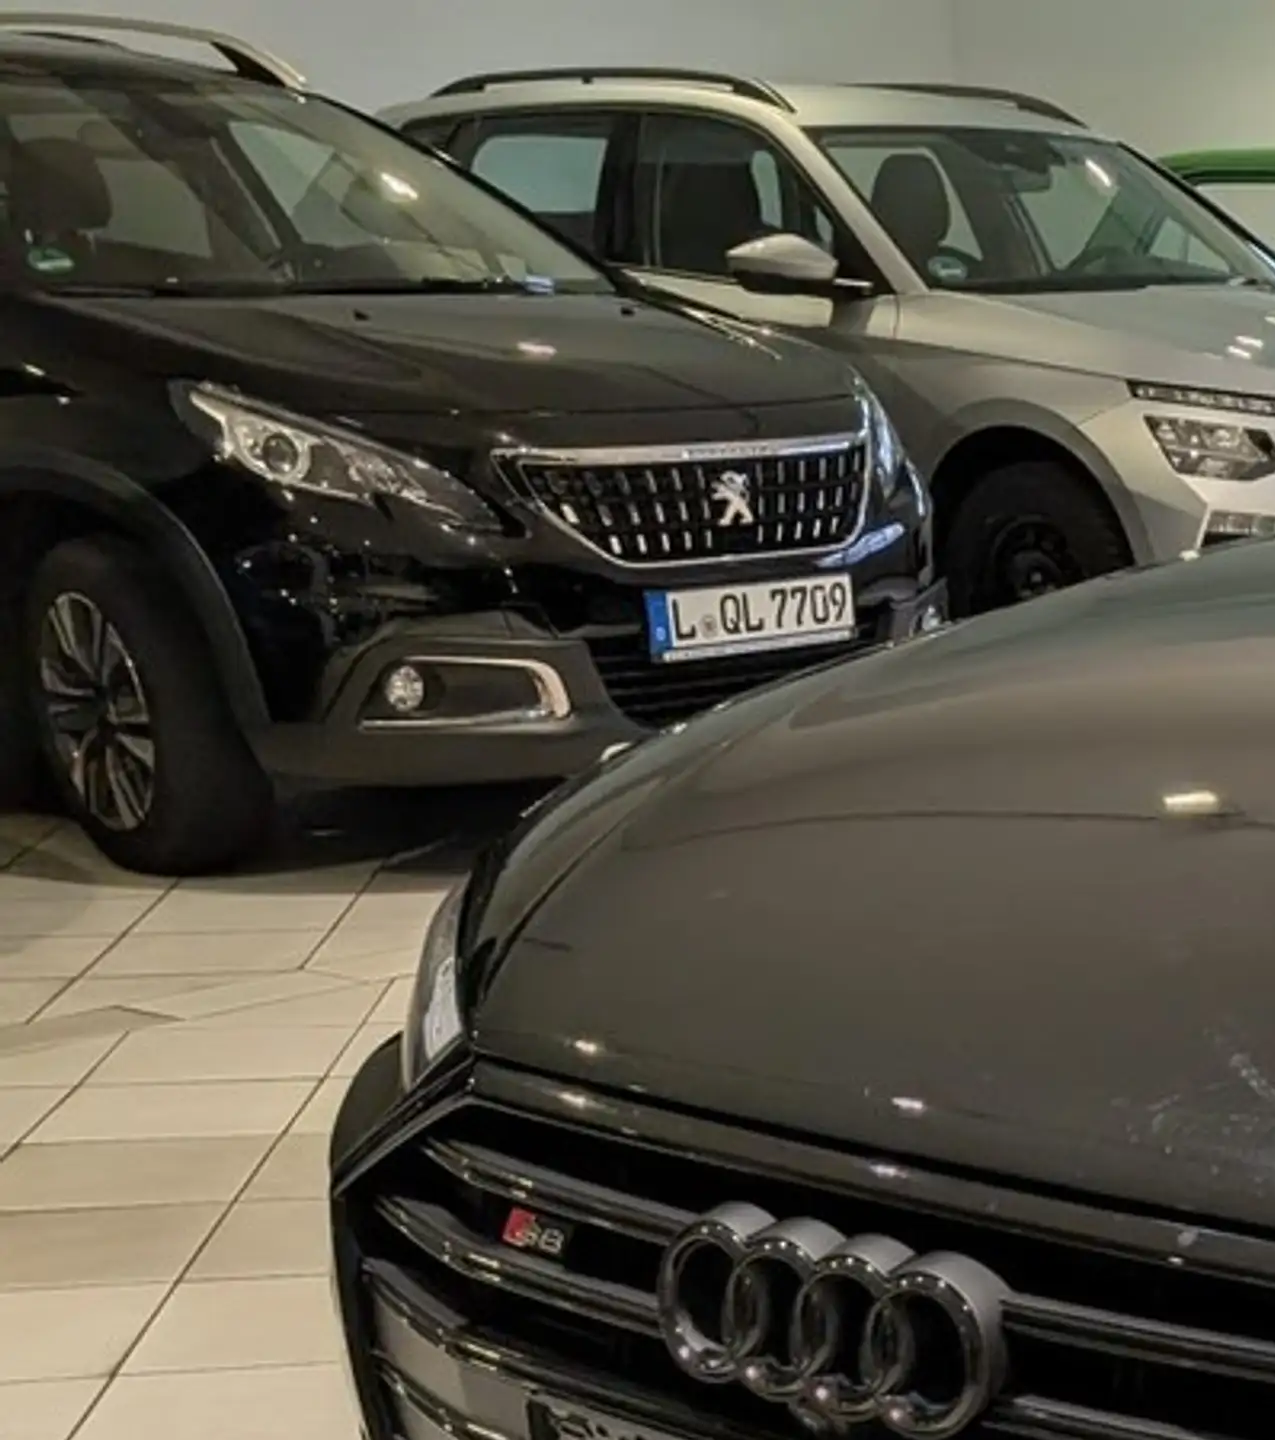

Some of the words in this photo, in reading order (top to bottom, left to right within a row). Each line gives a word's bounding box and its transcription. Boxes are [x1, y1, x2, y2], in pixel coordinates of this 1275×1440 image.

[671, 598, 696, 640] L
[719, 591, 765, 635] QL
[769, 581, 847, 629] 7709
